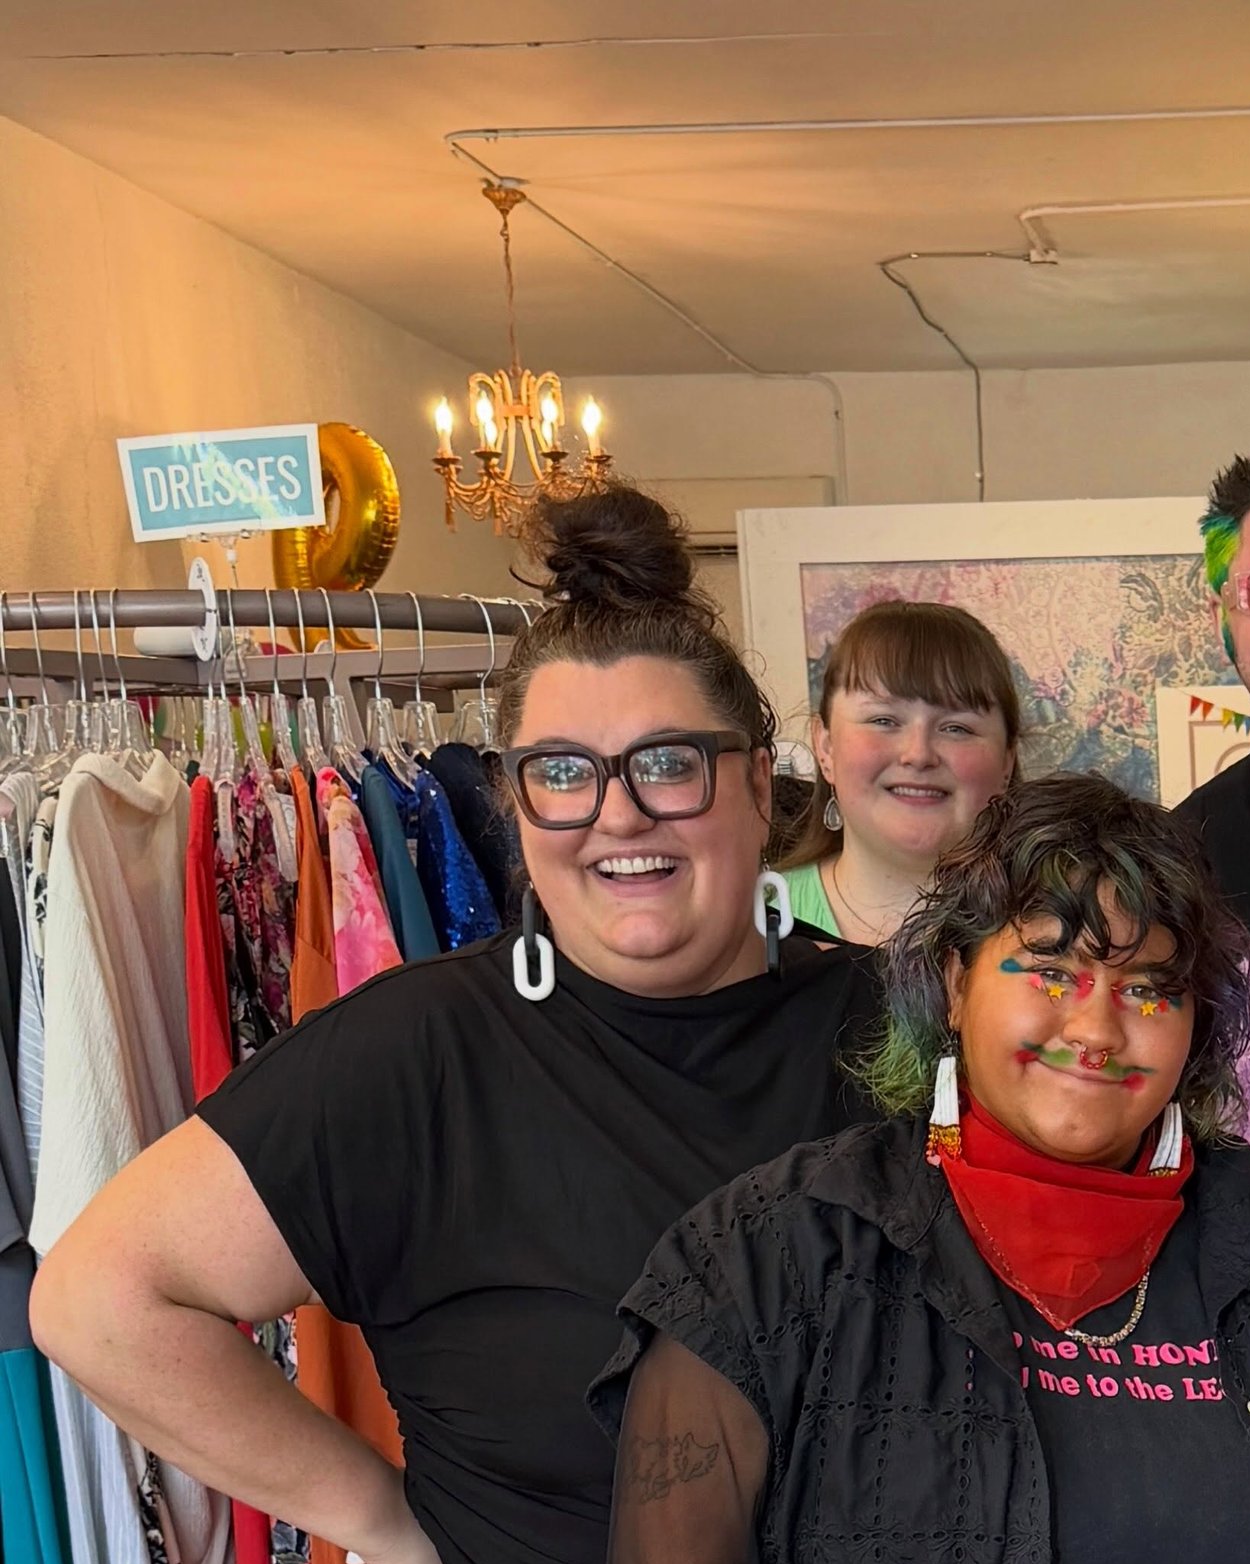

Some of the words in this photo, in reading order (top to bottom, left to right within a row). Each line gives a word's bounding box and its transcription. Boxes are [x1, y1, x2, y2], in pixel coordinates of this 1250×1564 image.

[143, 455, 302, 513] DRESSES
[1030, 1335, 1080, 1360] me
[1085, 1343, 1122, 1365] in
[1131, 1339, 1218, 1368] HON
[1038, 1368, 1081, 1396] me
[1086, 1373, 1119, 1398] to
[1124, 1376, 1175, 1401] the
[1182, 1377, 1226, 1401] LE
